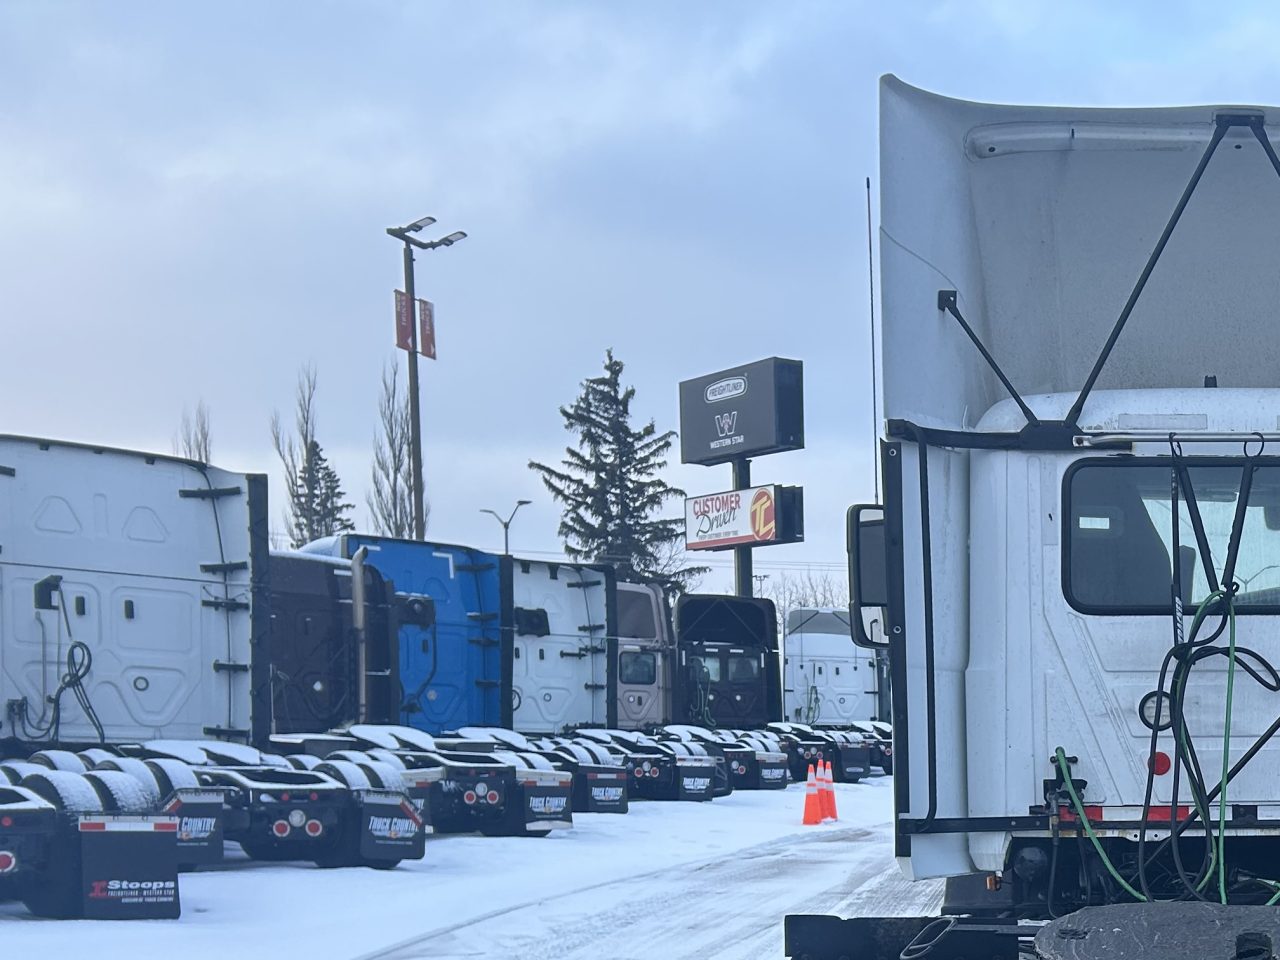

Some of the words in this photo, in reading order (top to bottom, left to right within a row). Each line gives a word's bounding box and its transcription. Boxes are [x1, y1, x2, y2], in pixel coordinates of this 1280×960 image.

[710, 438, 731, 449] WESTERN
[732, 435, 744, 445] STAR
[693, 493, 741, 516] CUSTOMER
[696, 507, 737, 538] Driven
[182, 816, 216, 832] COUNTRY
[369, 815, 390, 830] TRUCK
[107, 880, 175, 890] Stoops
